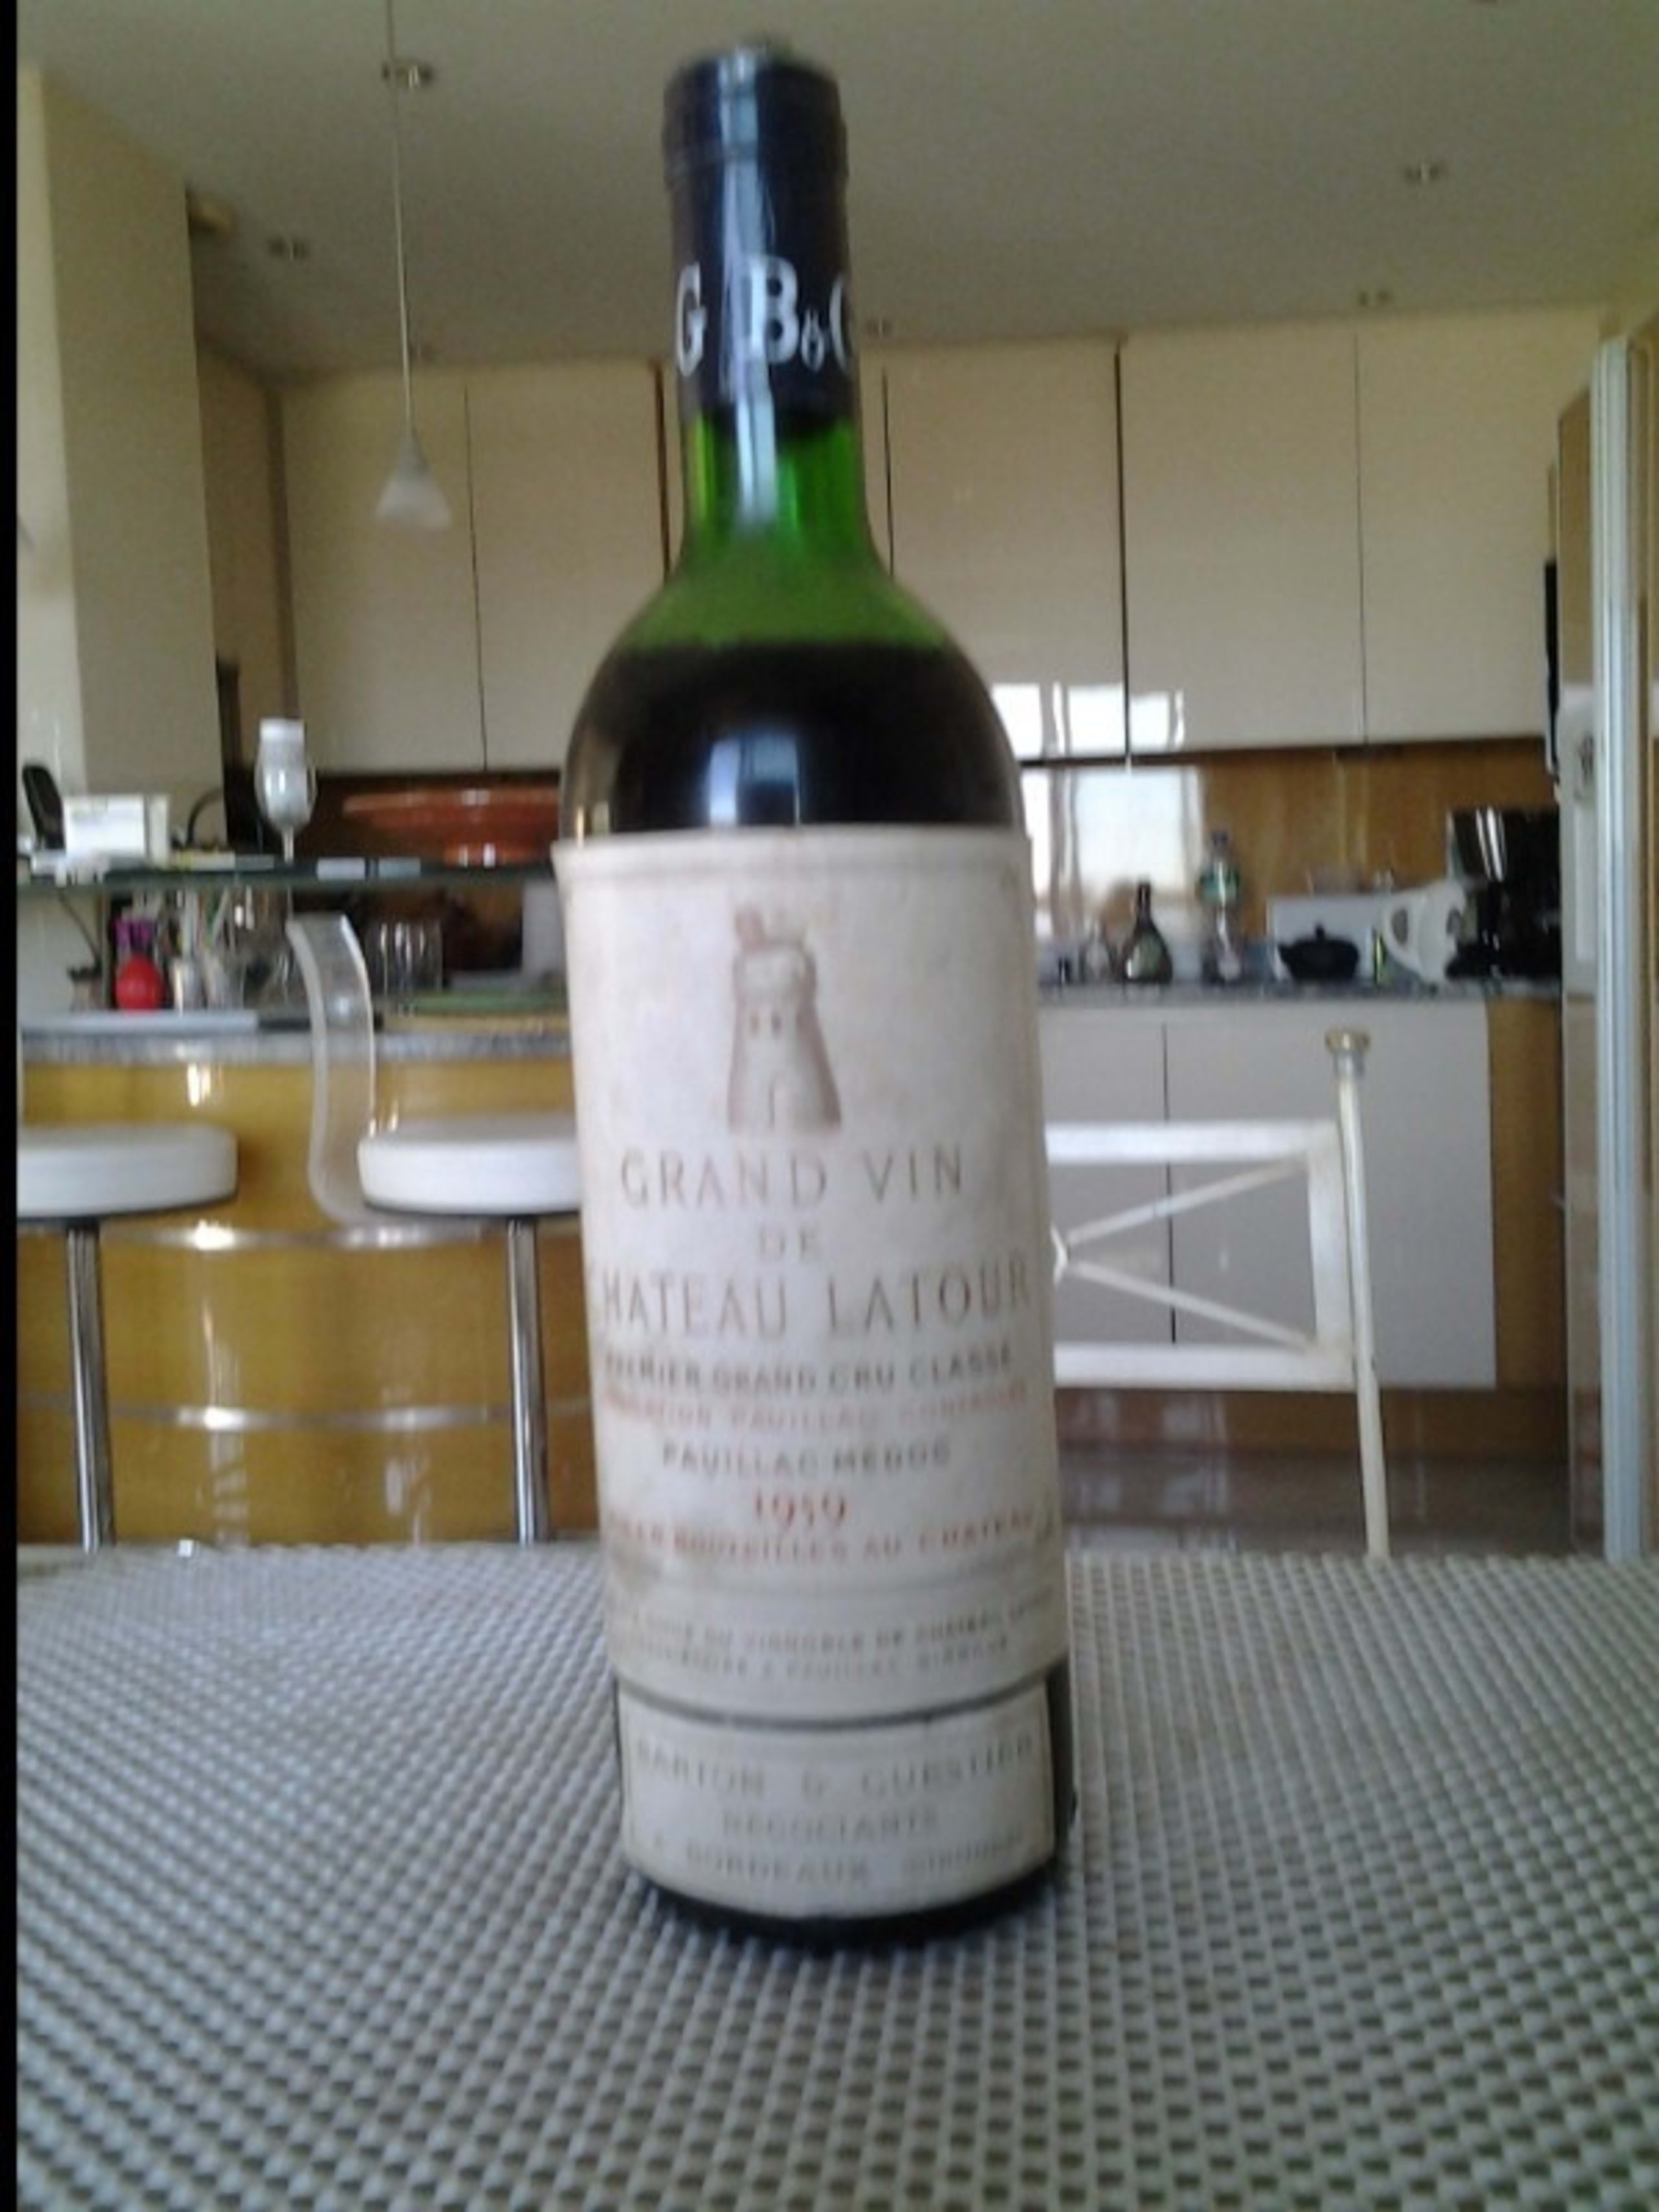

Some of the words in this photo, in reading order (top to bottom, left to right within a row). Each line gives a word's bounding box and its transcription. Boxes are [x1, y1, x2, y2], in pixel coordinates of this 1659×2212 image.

[620, 1147, 828, 1209] GRAND
[864, 1145, 962, 1201] VIN
[758, 1225, 822, 1263] DE
[592, 1264, 789, 1340] HATEAU
[827, 1251, 1030, 1334] LATOUR
